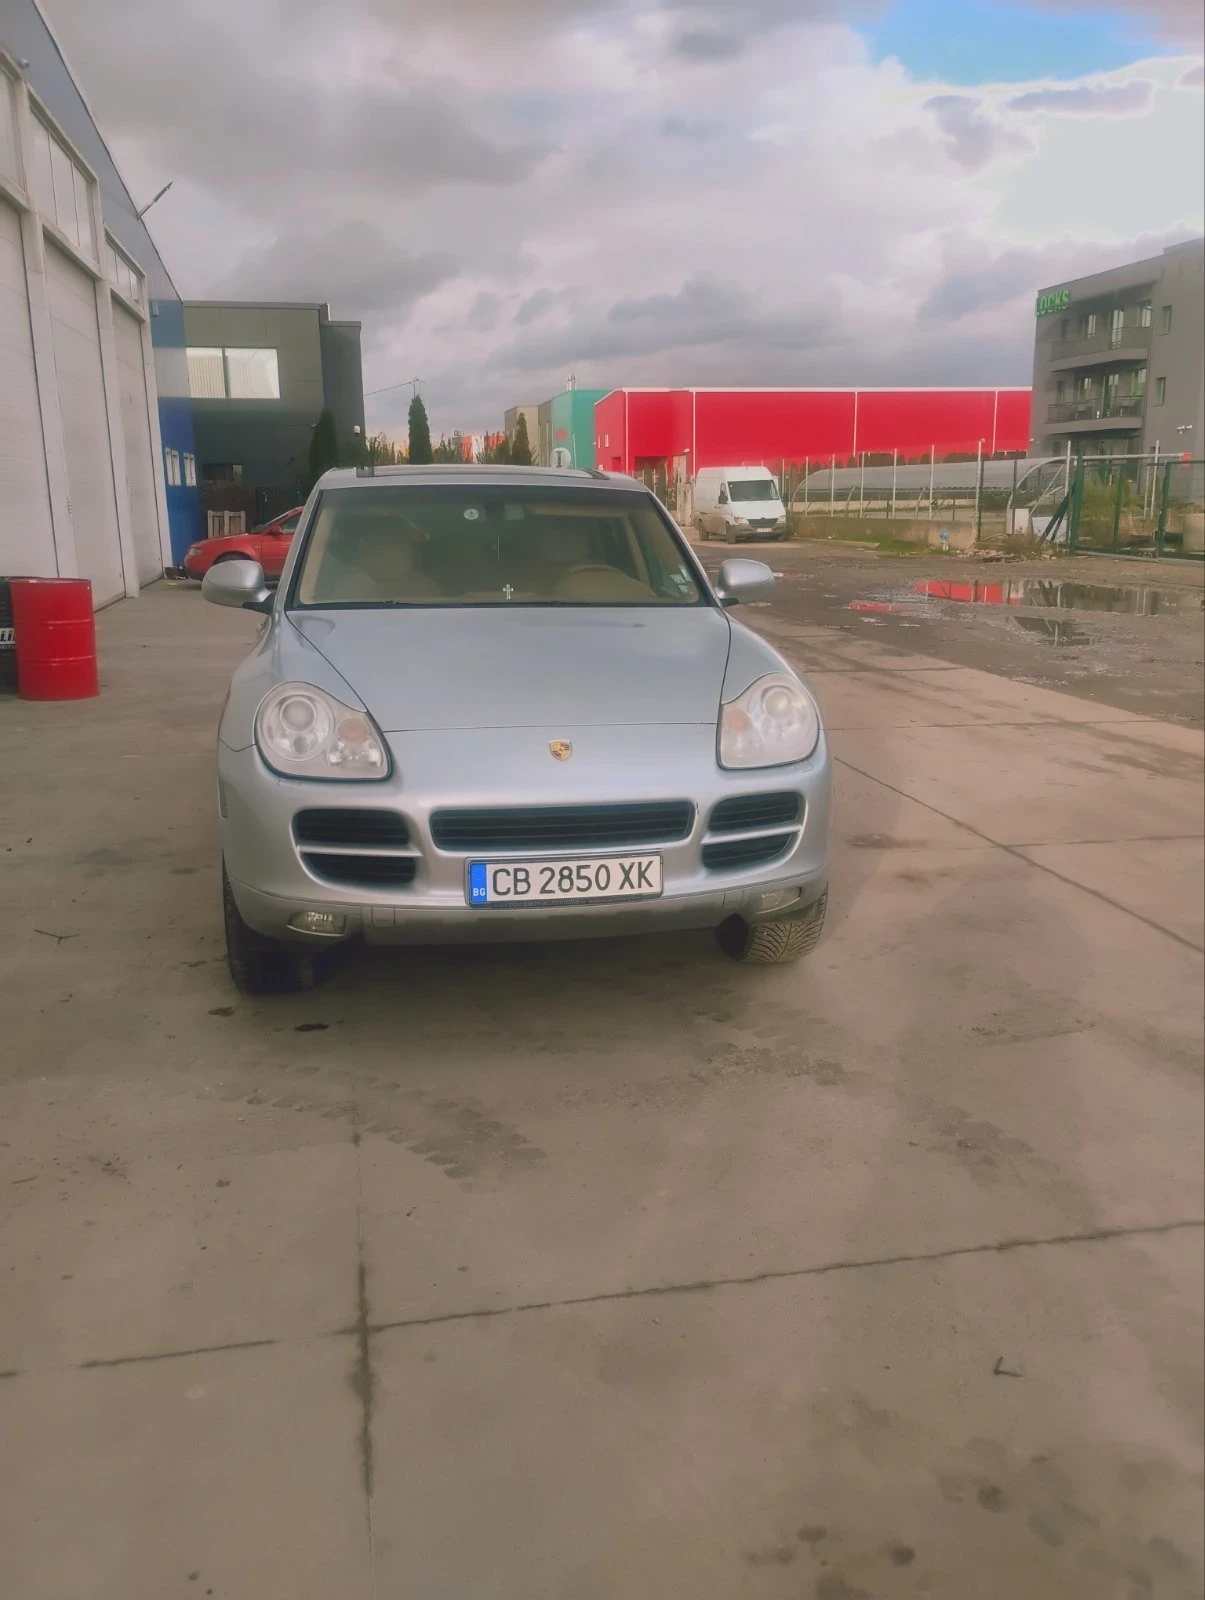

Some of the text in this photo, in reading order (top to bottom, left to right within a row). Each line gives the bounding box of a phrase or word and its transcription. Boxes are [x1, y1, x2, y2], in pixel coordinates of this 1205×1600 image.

[492, 860, 654, 896] CB 2850 XK
[473, 888, 486, 897] BG
